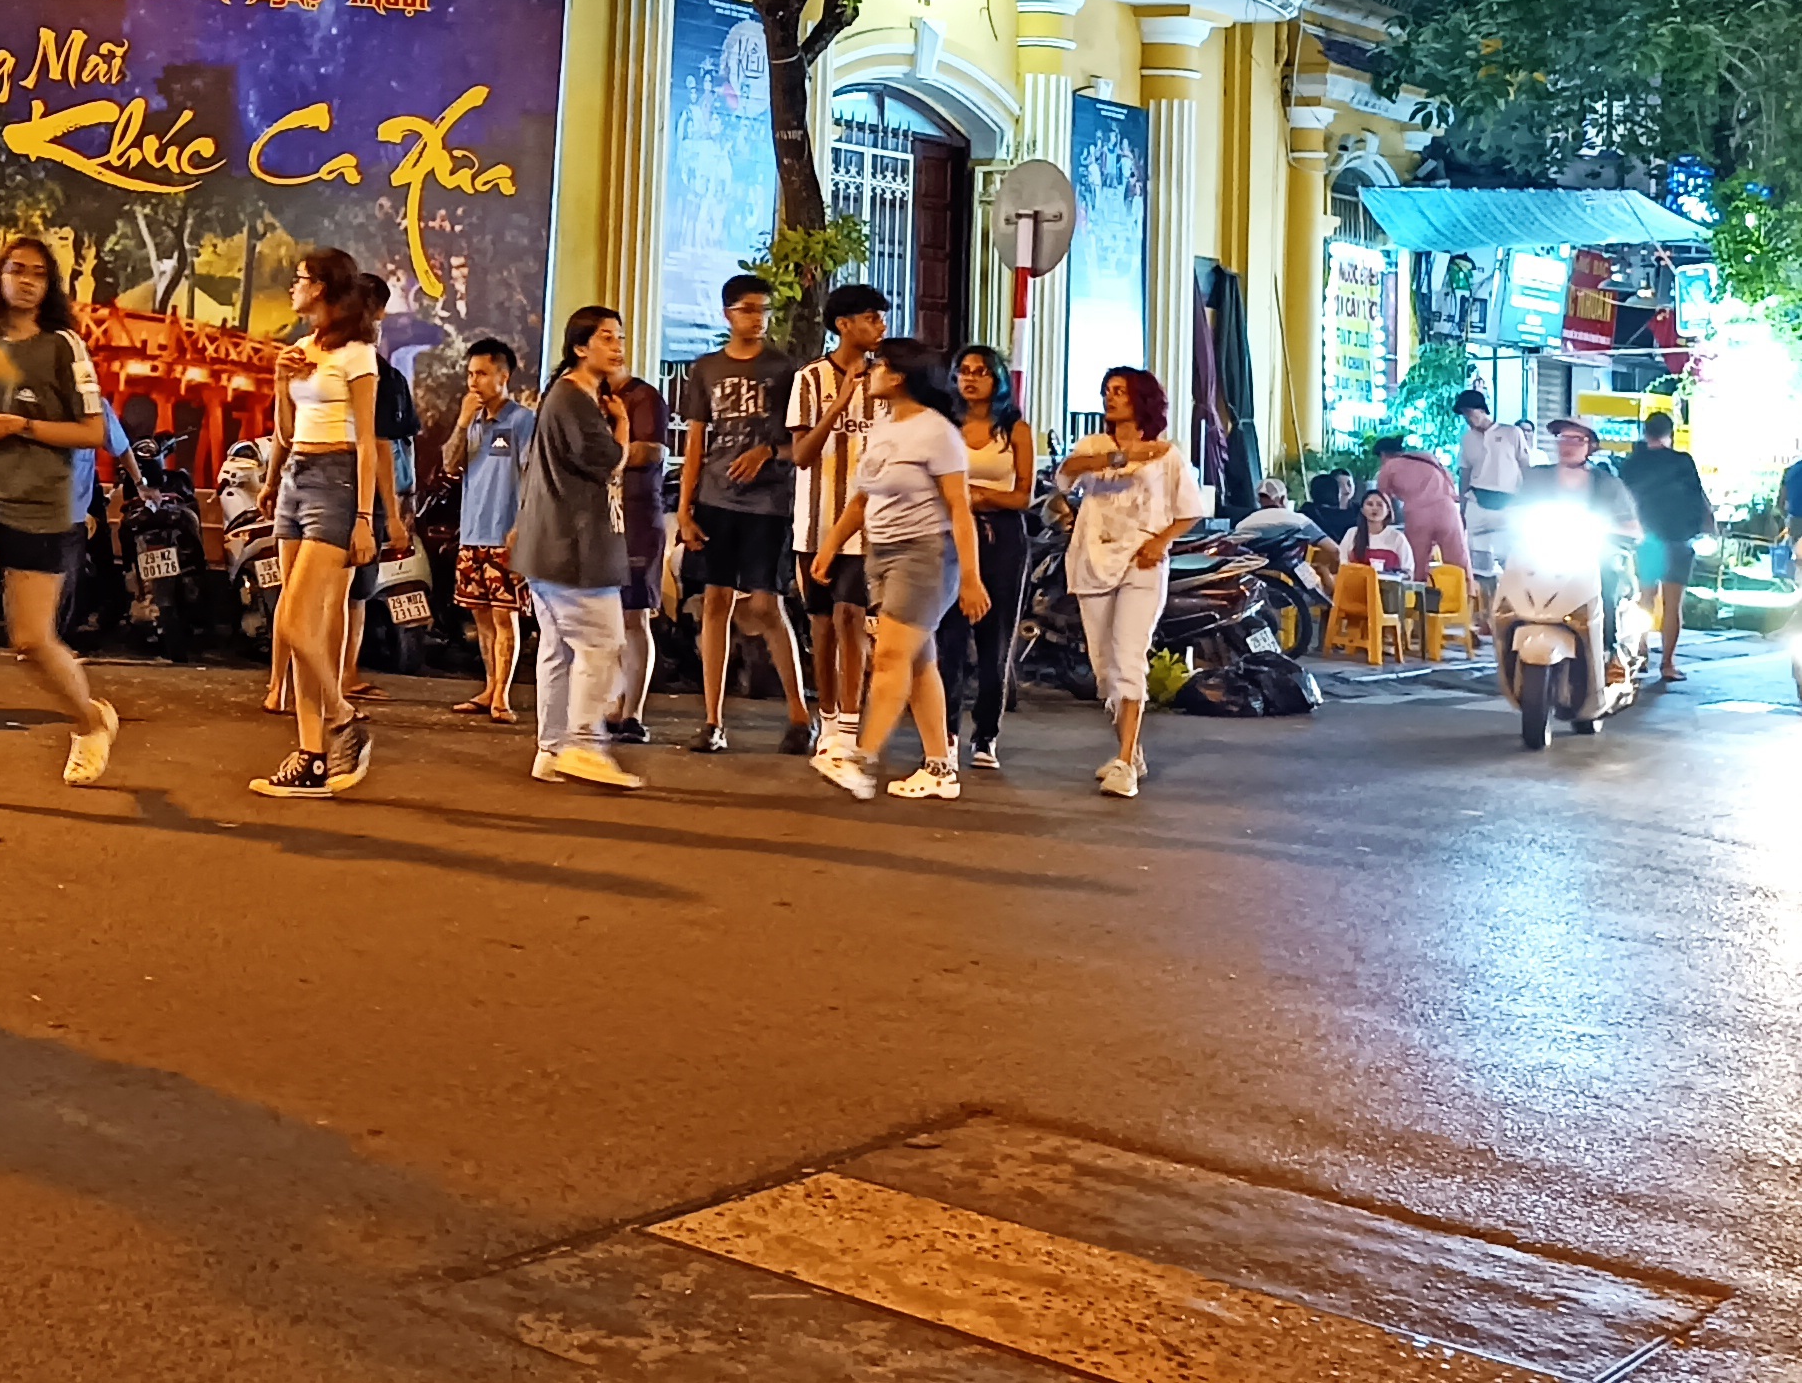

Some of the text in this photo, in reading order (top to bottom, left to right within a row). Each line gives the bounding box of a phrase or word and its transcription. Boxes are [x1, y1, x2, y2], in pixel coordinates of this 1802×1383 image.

[19, 26, 129, 92] Mãi
[1, 84, 517, 299] Khúc Ca Xưa
[831, 412, 874, 434] Jee
[143, 561, 177, 577] 001.26
[393, 604, 427, 621] 231.31
